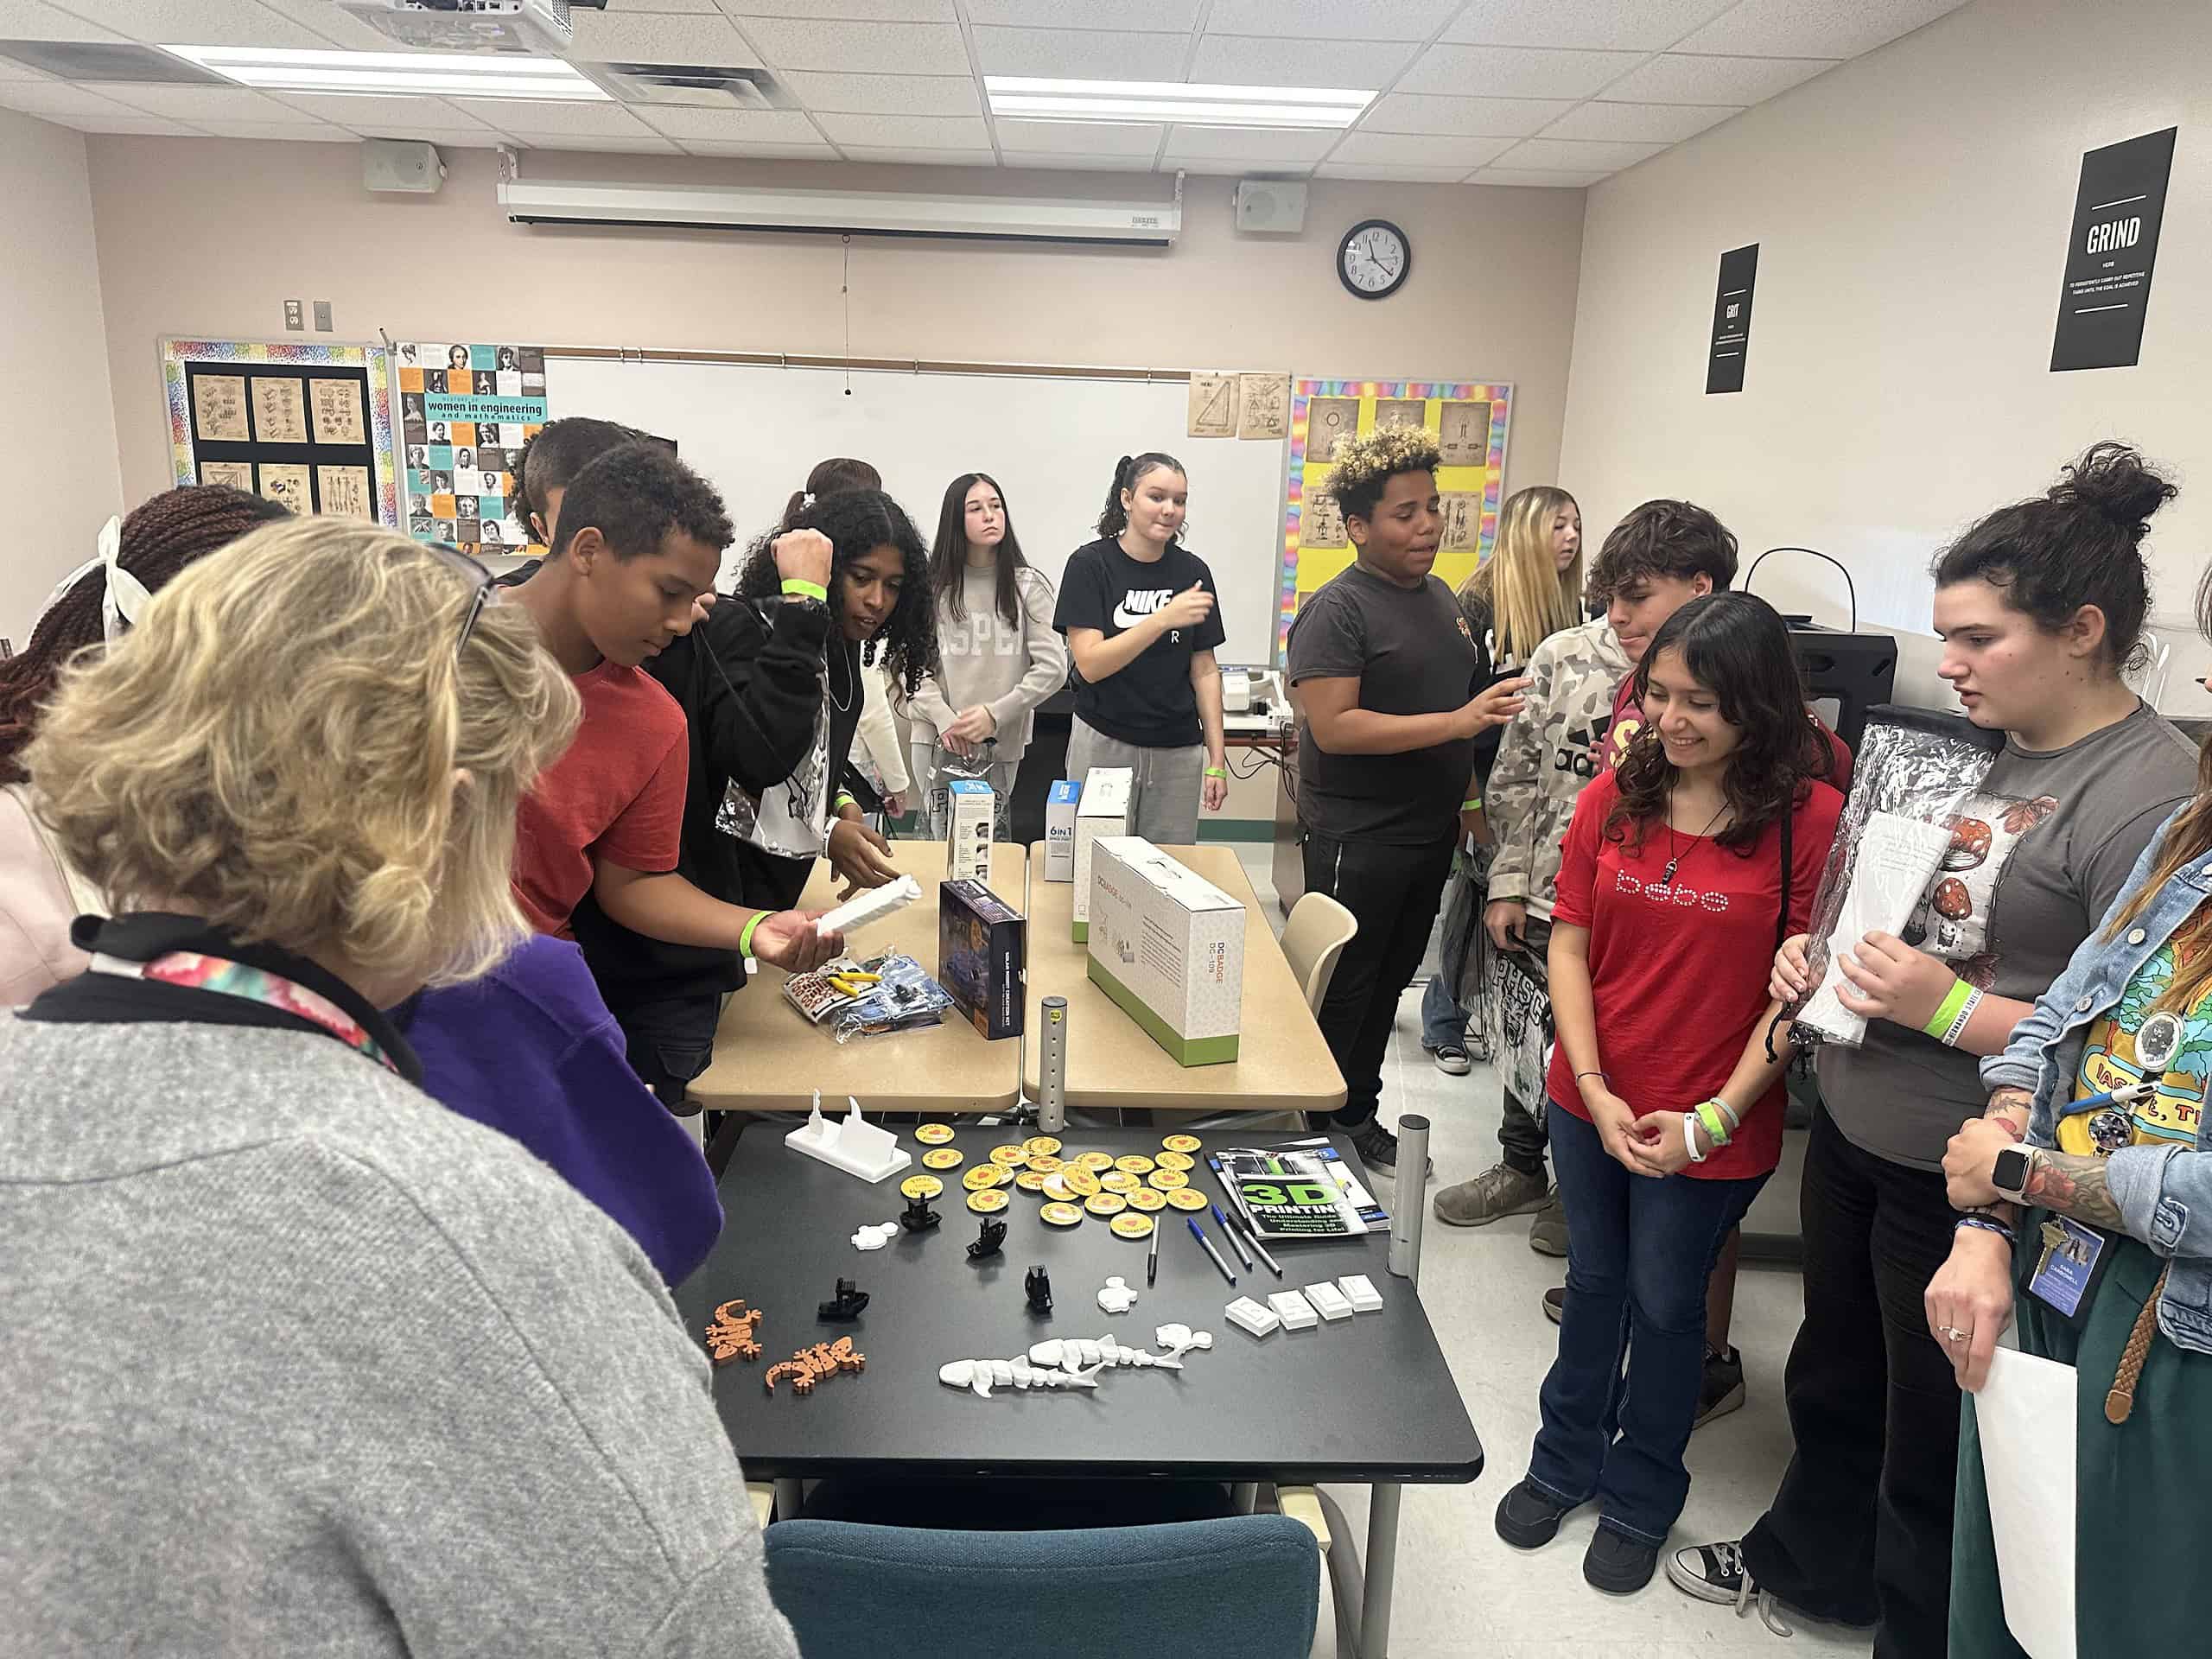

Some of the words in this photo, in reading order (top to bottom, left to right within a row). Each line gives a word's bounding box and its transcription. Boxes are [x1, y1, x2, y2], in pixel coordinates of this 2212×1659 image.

[1362, 234, 1368, 245] 11
[1372, 232, 1380, 242] 12
[2087, 217, 2141, 254] GRIND
[1389, 244, 1397, 254] 2
[1358, 274, 1364, 284] 7
[1368, 276, 1375, 288] 6
[1726, 303, 1739, 319] GRIT
[429, 403, 466, 411] women
[468, 401, 478, 412] in
[480, 403, 542, 416] engineering
[1124, 589, 1173, 613] NIKE
[1050, 826, 1058, 836] 6
[1616, 869, 1729, 912] bebe
[1217, 942, 1225, 984] DCBADGE
[1492, 958, 1547, 1027] PHSC
[1243, 1184, 1342, 1205] 3D
